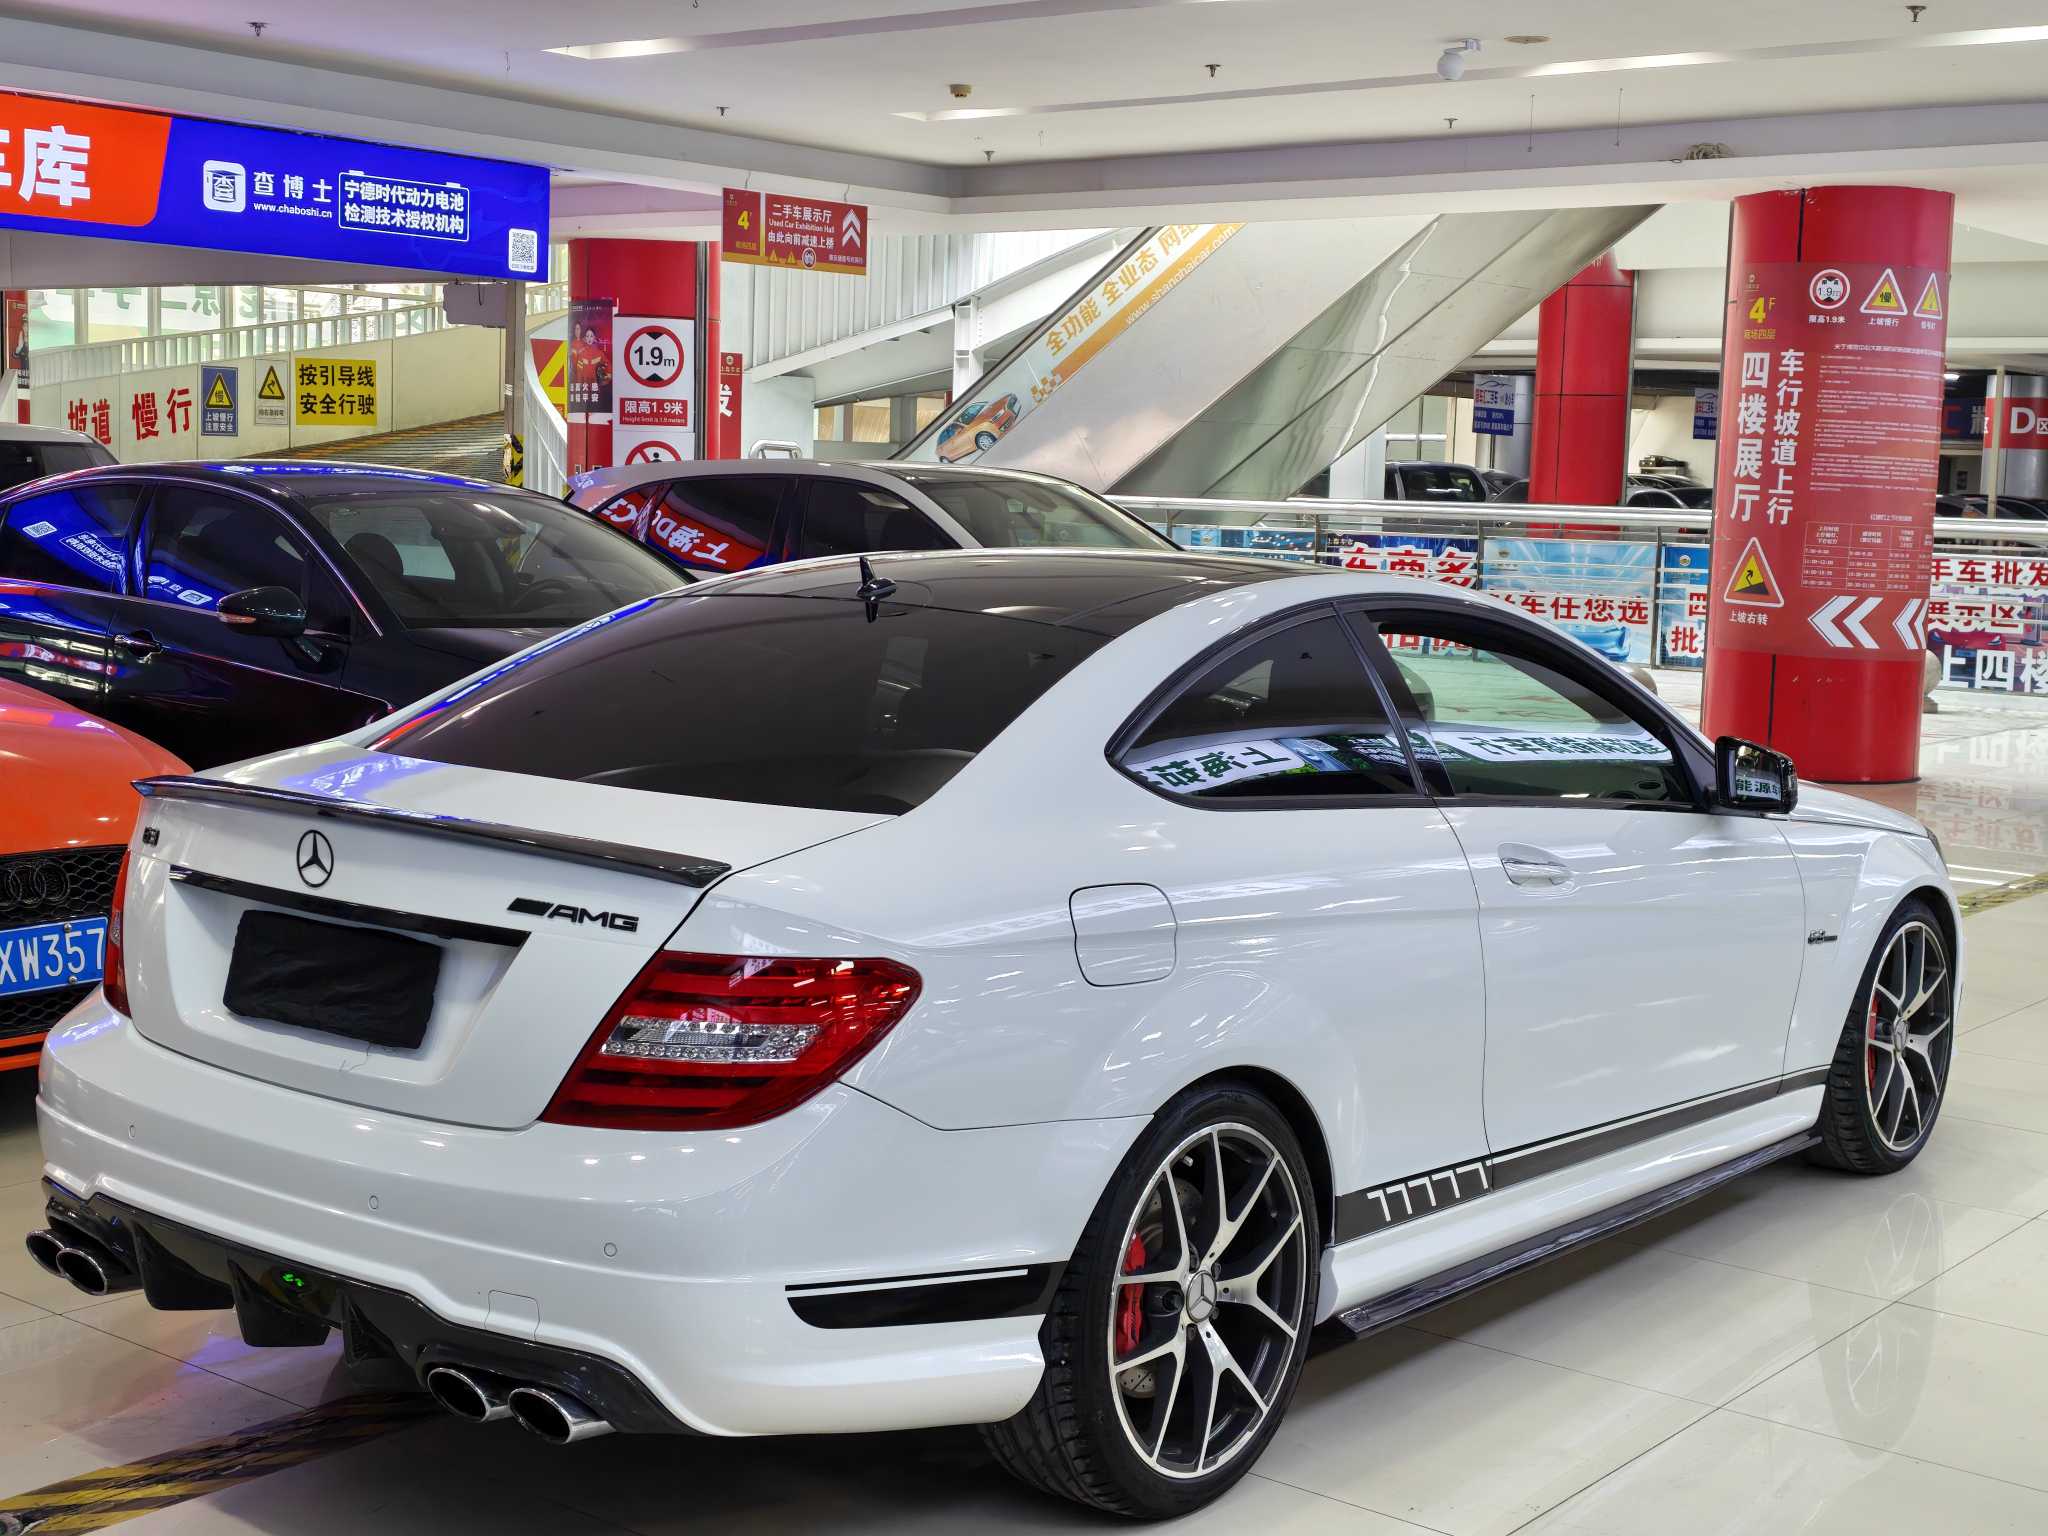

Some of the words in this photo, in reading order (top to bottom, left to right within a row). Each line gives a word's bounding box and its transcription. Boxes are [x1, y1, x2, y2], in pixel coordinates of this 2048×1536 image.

[344, 179, 465, 212] 宁德时代动力电池
[253, 202, 333, 218] www.chaboshi.cn
[344, 202, 465, 235] 检测技术授权机构
[737, 210, 750, 230] 4
[772, 203, 832, 224] 二手车展示厅
[1103, 248, 1159, 306] 全业态
[1046, 296, 1101, 356] 全功能
[299, 365, 374, 388] 按引导线
[132, 387, 192, 441] 慢行
[205, 412, 233, 423] 上坡慢行
[300, 393, 375, 415] 安全行驶
[625, 400, 684, 415] 限高1.9米
[68, 398, 112, 445] 坡道
[205, 422, 233, 433] 注意安全
[1730, 351, 1771, 522] 四楼展厅
[1767, 348, 1805, 525] 车行坡道上行
[1729, 610, 1768, 625] 上坡右转
[1671, 626, 1706, 654] 批
[547, 903, 640, 932] AMG
[0, 927, 104, 984] XW357
